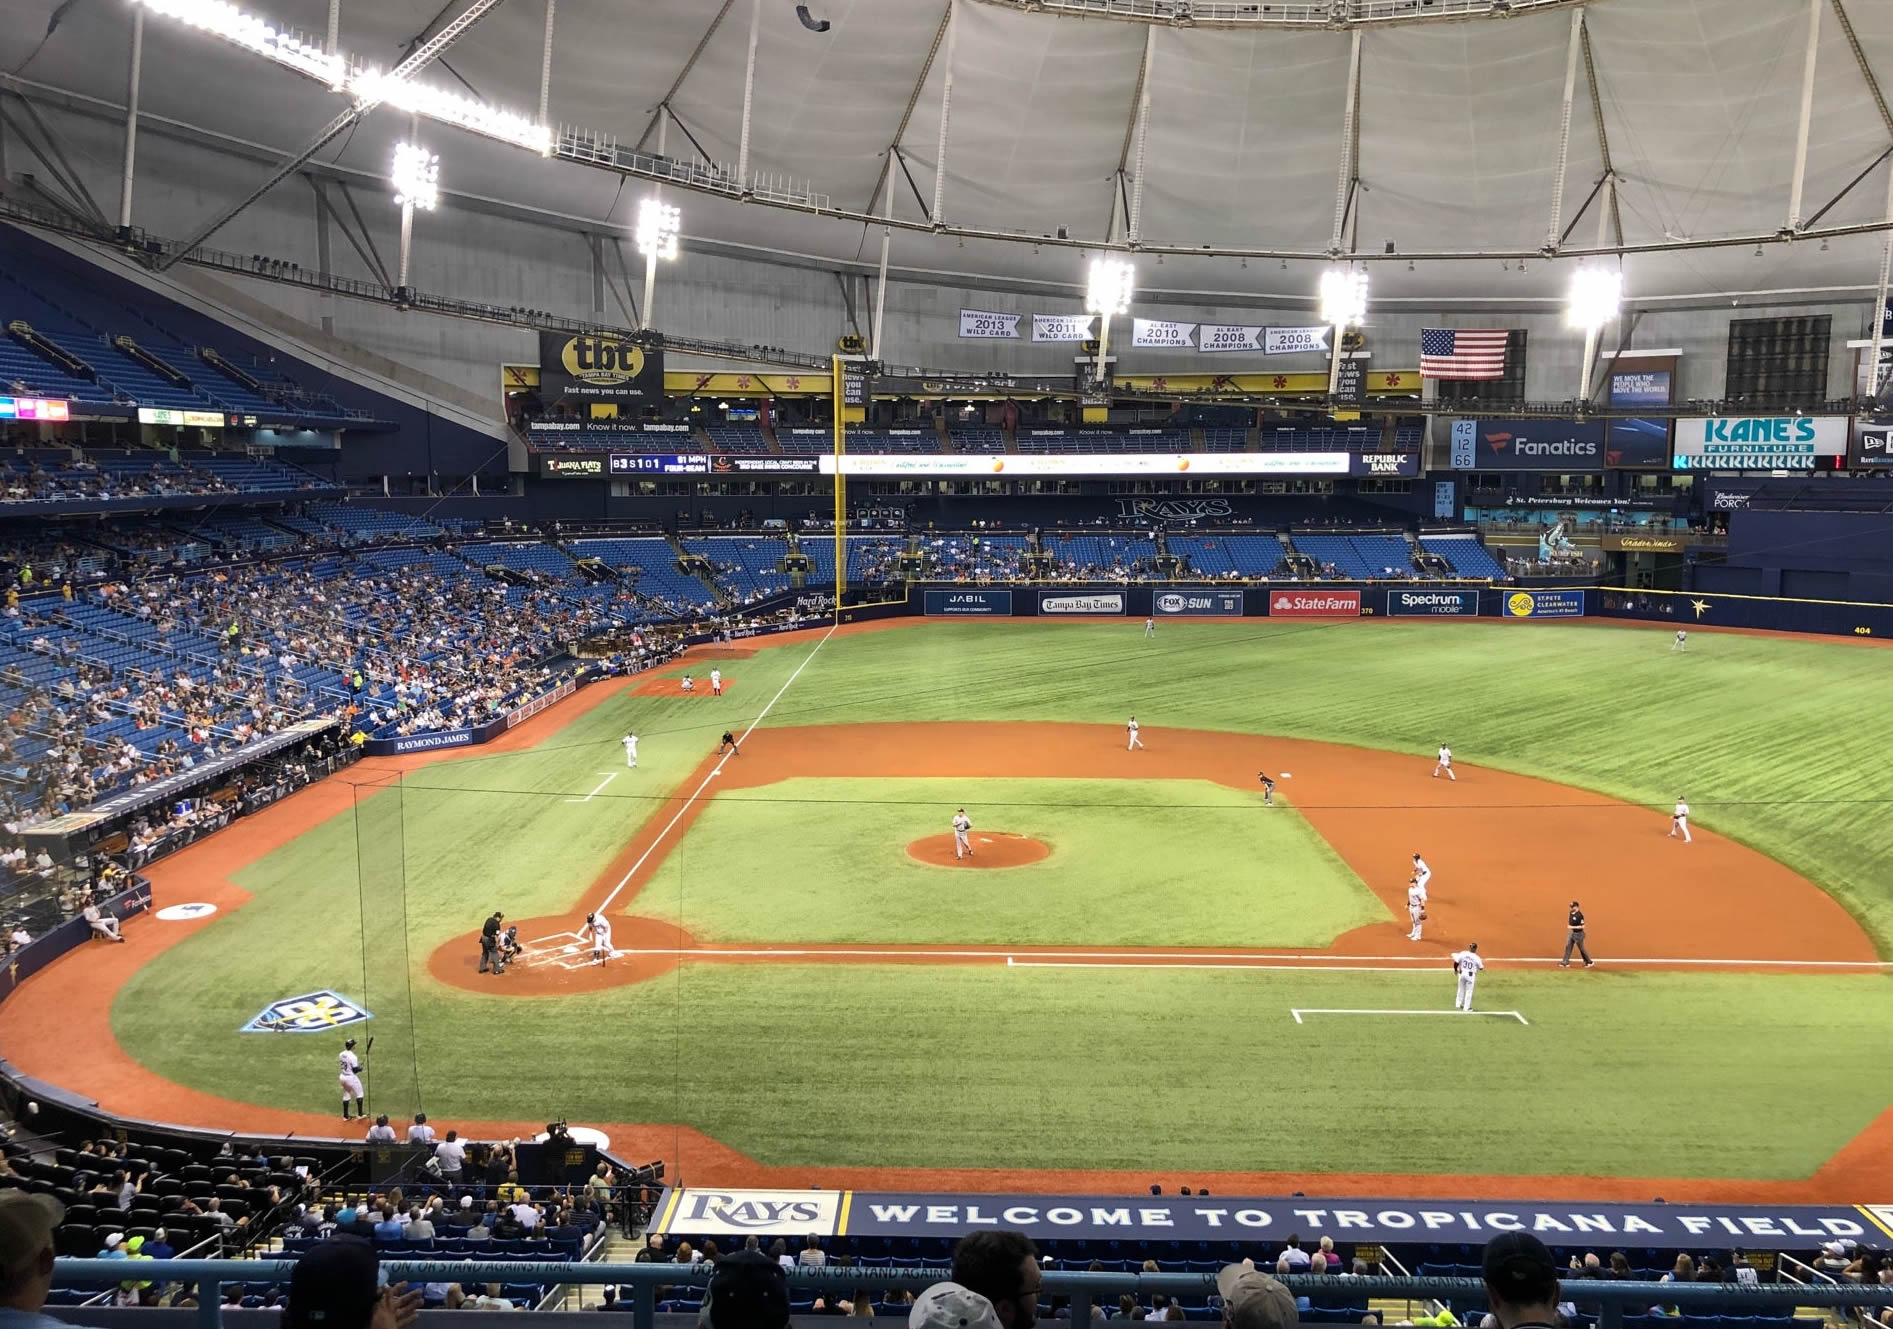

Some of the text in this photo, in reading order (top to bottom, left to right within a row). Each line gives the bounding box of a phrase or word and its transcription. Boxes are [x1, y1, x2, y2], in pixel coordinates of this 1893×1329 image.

[975, 320, 1005, 330] 2013
[1047, 324, 1076, 332] 2011
[1147, 329, 1179, 338] 2010
[1214, 333, 1245, 342] 2008
[1137, 337, 1186, 346] CHAMPIONS
[1280, 335, 1312, 344] 2008
[1270, 343, 1320, 351] CHAMPIONS
[573, 338, 634, 371] tbt
[845, 380, 861, 389] you
[564, 386, 579, 394] Fast
[601, 388, 614, 396] you
[531, 422, 580, 431] tampabay.com
[587, 423, 610, 431] Know
[612, 423, 617, 431] it
[643, 423, 689, 432] tampabay.com
[1456, 423, 1472, 434] 42
[1705, 418, 1815, 442] KANE'S
[1458, 439, 1469, 450] 12
[1515, 437, 1596, 455] Fanatics
[613, 459, 659, 468] B 3 S 1 1
[1362, 454, 1407, 463] REPUBLIC
[1455, 455, 1471, 466] 66
[1371, 463, 1398, 471] BANK
[1528, 497, 1572, 505] Petersburg
[1115, 498, 1232, 520] RAYS
[797, 595, 837, 606] Hard Rock
[949, 595, 986, 603] JABIL
[1188, 597, 1212, 608] SUN
[1401, 593, 1460, 606] Spectrum
[1047, 599, 1119, 610] Tampa Bay Times
[1432, 605, 1460, 613] mobile
[1854, 626, 1871, 634] 404
[397, 734, 469, 750] RAYMOND JAMES
[682, 1194, 819, 1228] RAYS
[869, 1205, 1864, 1236] WELCOME TO TROPICANA FIELD
[320, 1229, 331, 1239] 11
[418, 1262, 436, 1272] OR
[438, 1262, 482, 1272] STAND
[485, 1263, 540, 1272] AGAINST
[545, 1263, 573, 1272] RAIL
[807, 1266, 830, 1279] ON,
[834, 1266, 852, 1277] OR
[856, 1267, 898, 1279] STAND
[902, 1268, 951, 1279] AGAINS
[1301, 1275, 1315, 1287] SIT
[1321, 1275, 1344, 1288] ON,
[1345, 1276, 1367, 1287] OR
[1370, 1276, 1414, 1288] STAND
[1418, 1276, 1480, 1288] AGAINST
